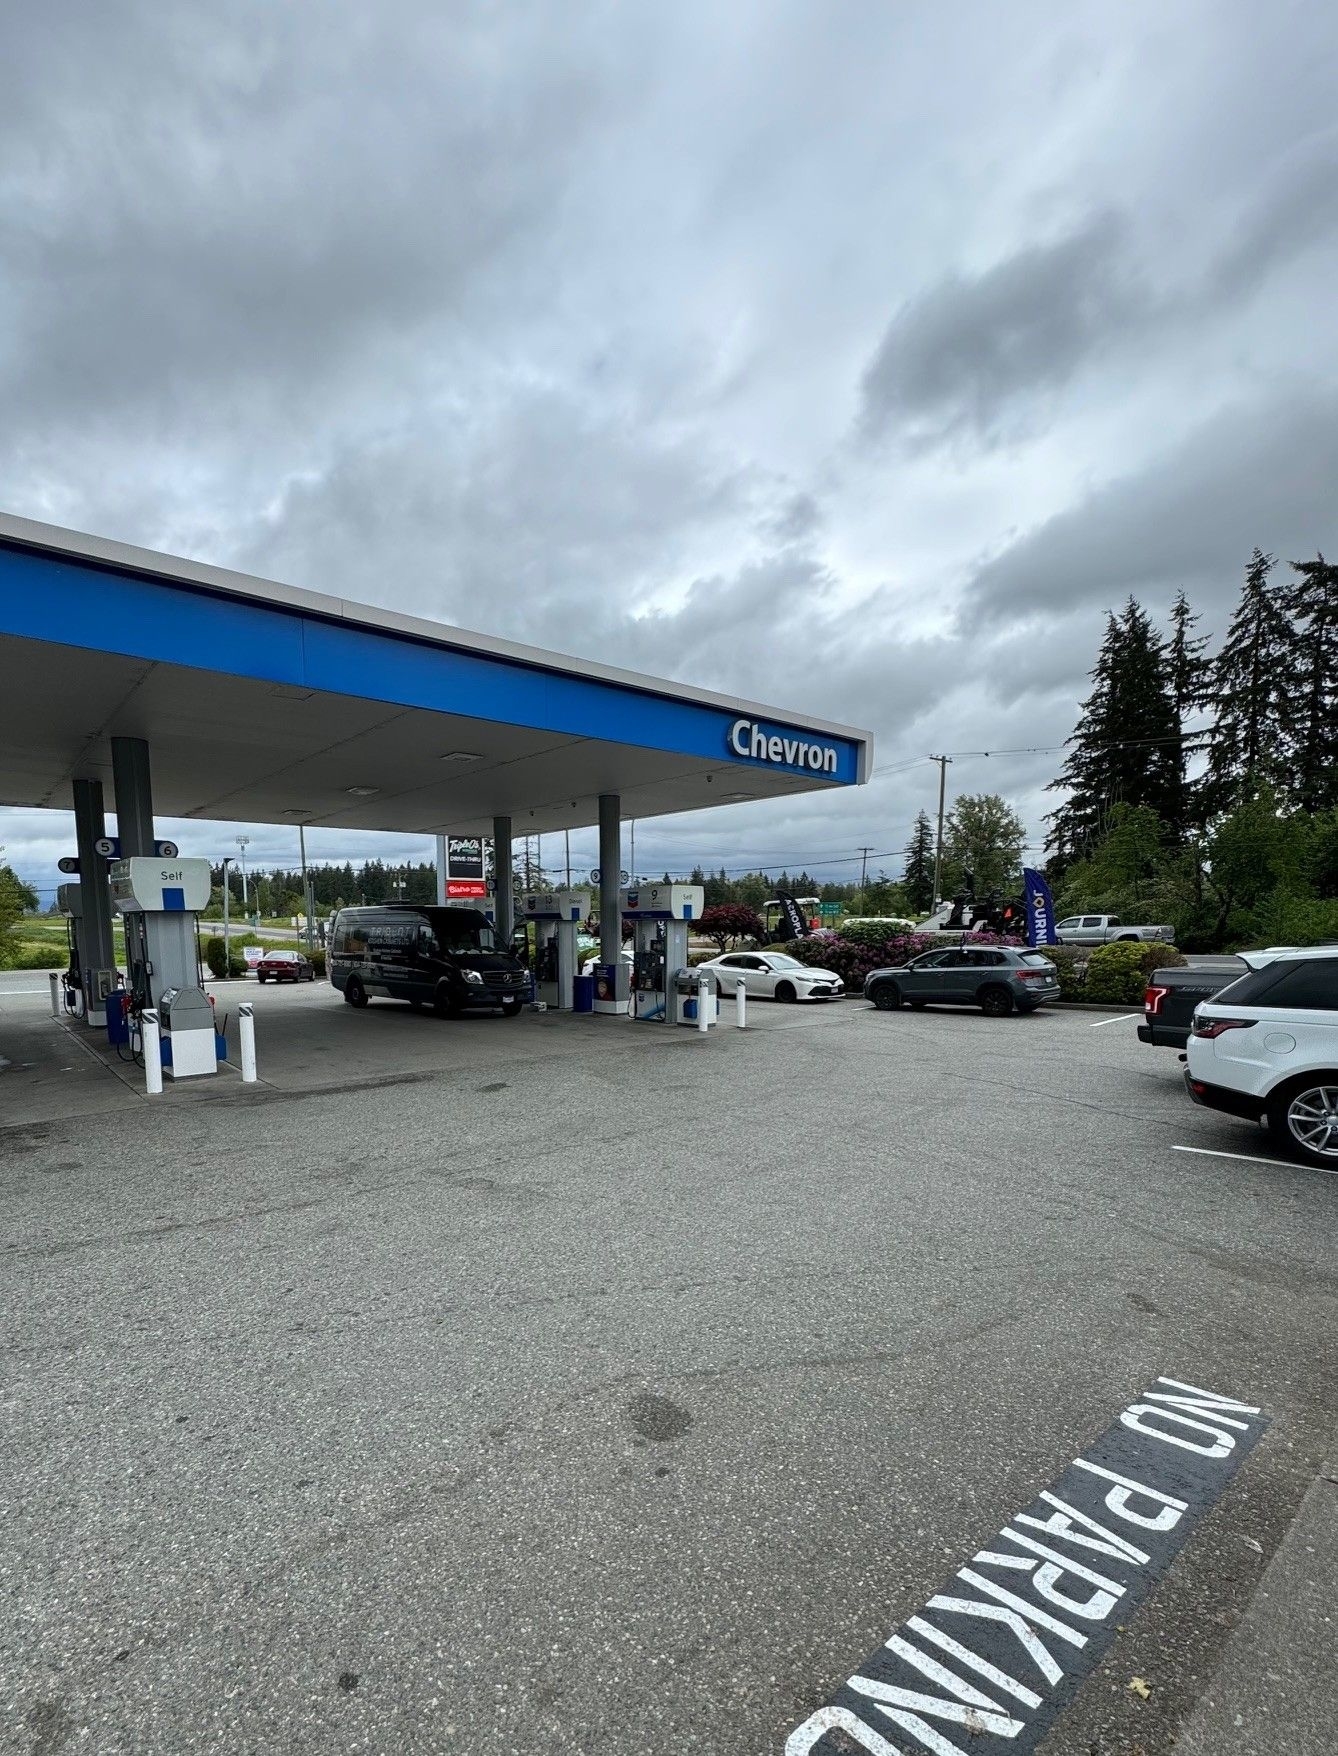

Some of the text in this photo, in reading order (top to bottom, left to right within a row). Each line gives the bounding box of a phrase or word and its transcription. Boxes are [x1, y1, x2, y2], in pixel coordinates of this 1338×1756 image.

[732, 719, 837, 773] Chevron
[101, 842, 110, 853] 5
[164, 845, 172, 856] 6
[160, 871, 183, 881] Self
[651, 889, 658, 901] 9
[1033, 890, 1048, 948] JOURNI
[1120, 1376, 1260, 1458] NO
